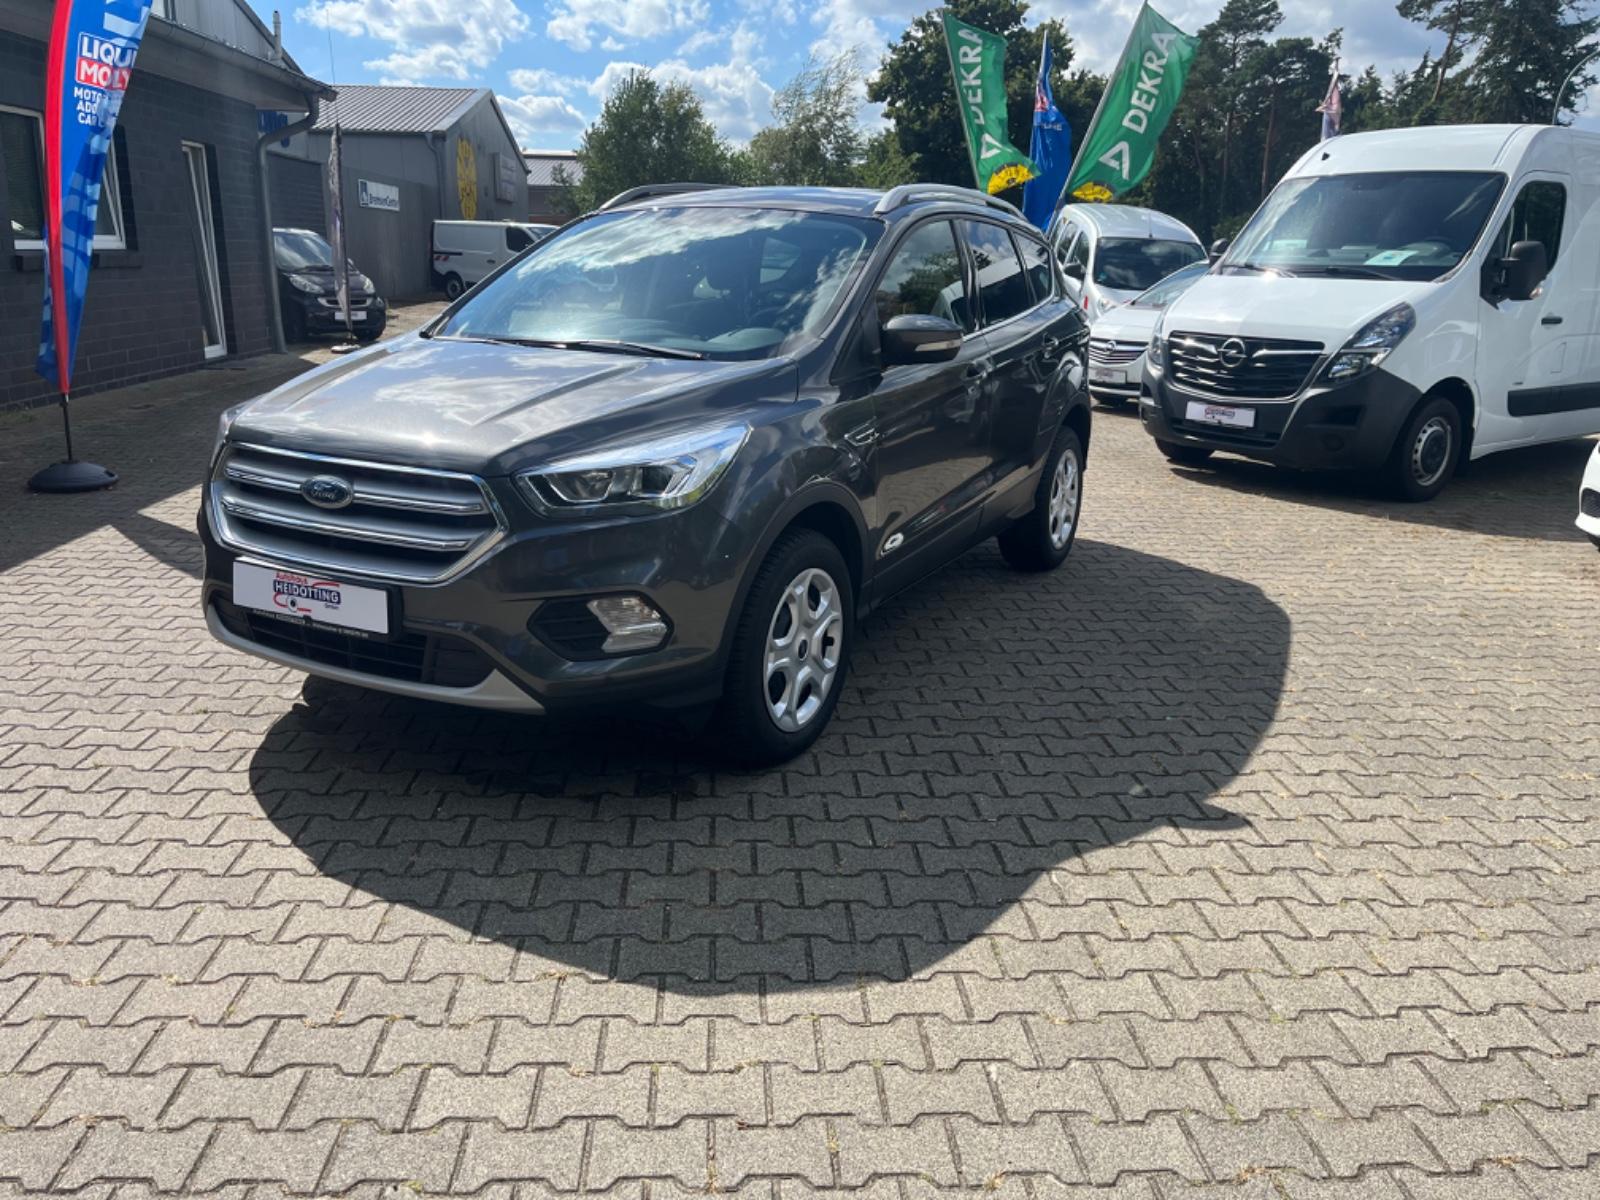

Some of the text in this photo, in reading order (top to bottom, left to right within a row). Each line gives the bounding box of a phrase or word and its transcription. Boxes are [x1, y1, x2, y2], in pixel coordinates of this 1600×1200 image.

[79, 60, 130, 88] MOLY
[958, 29, 985, 125] DEKRA
[1122, 32, 1177, 134] DEKRA
